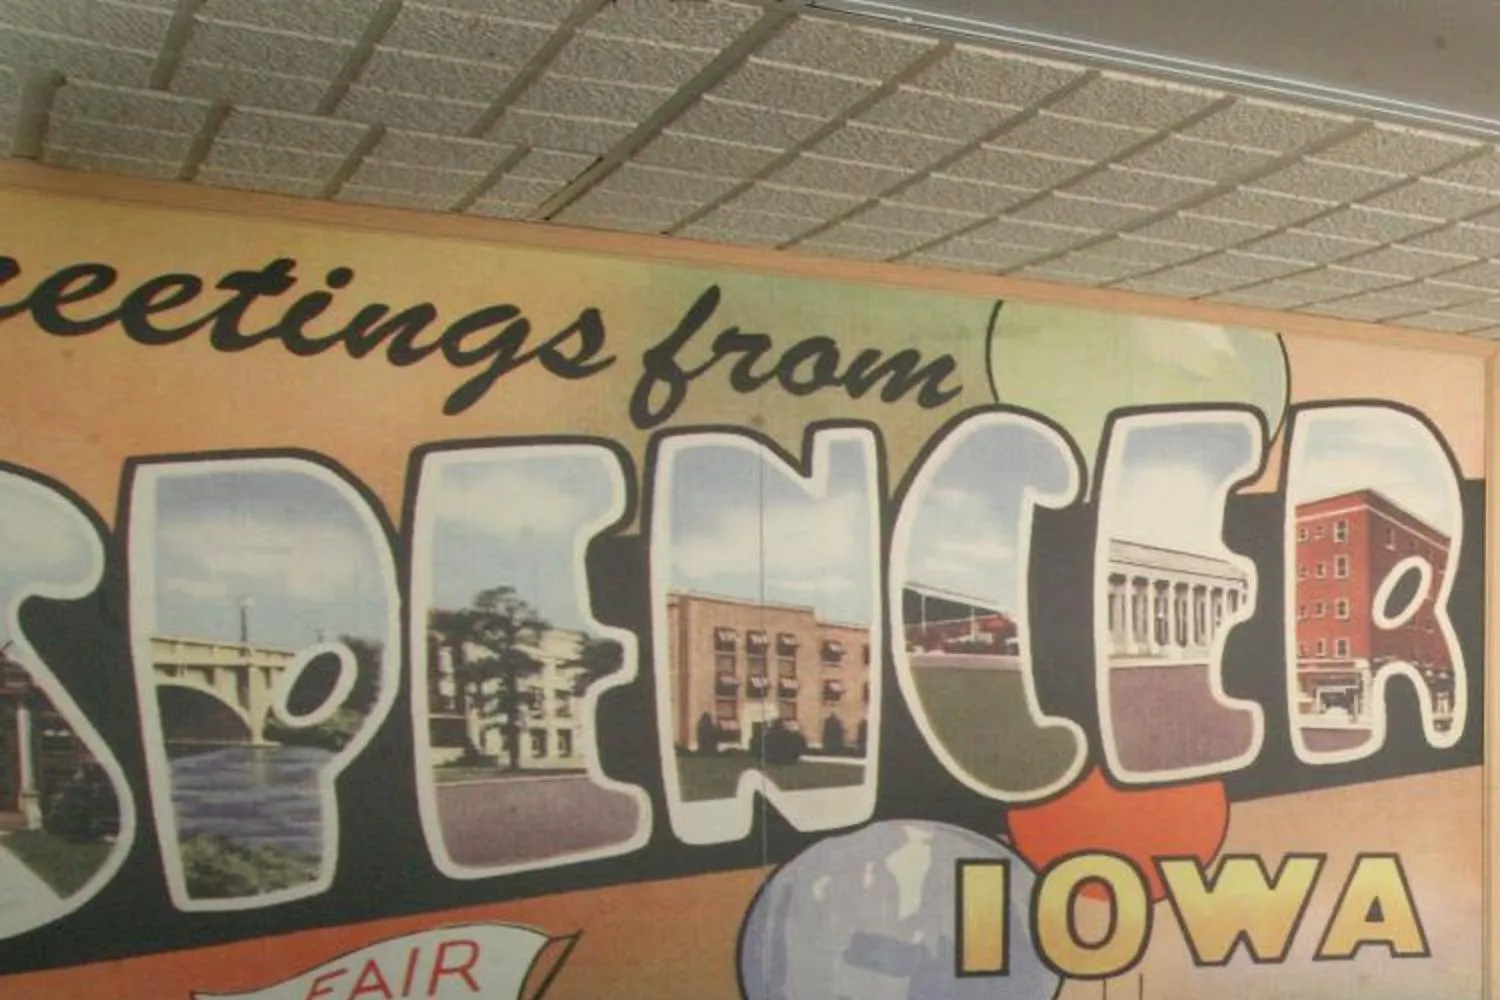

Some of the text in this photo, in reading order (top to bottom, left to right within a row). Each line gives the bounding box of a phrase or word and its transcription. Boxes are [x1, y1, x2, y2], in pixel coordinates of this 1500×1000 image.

[0, 256, 963, 430] eetings from
[954, 848, 1432, 980] IOWA
